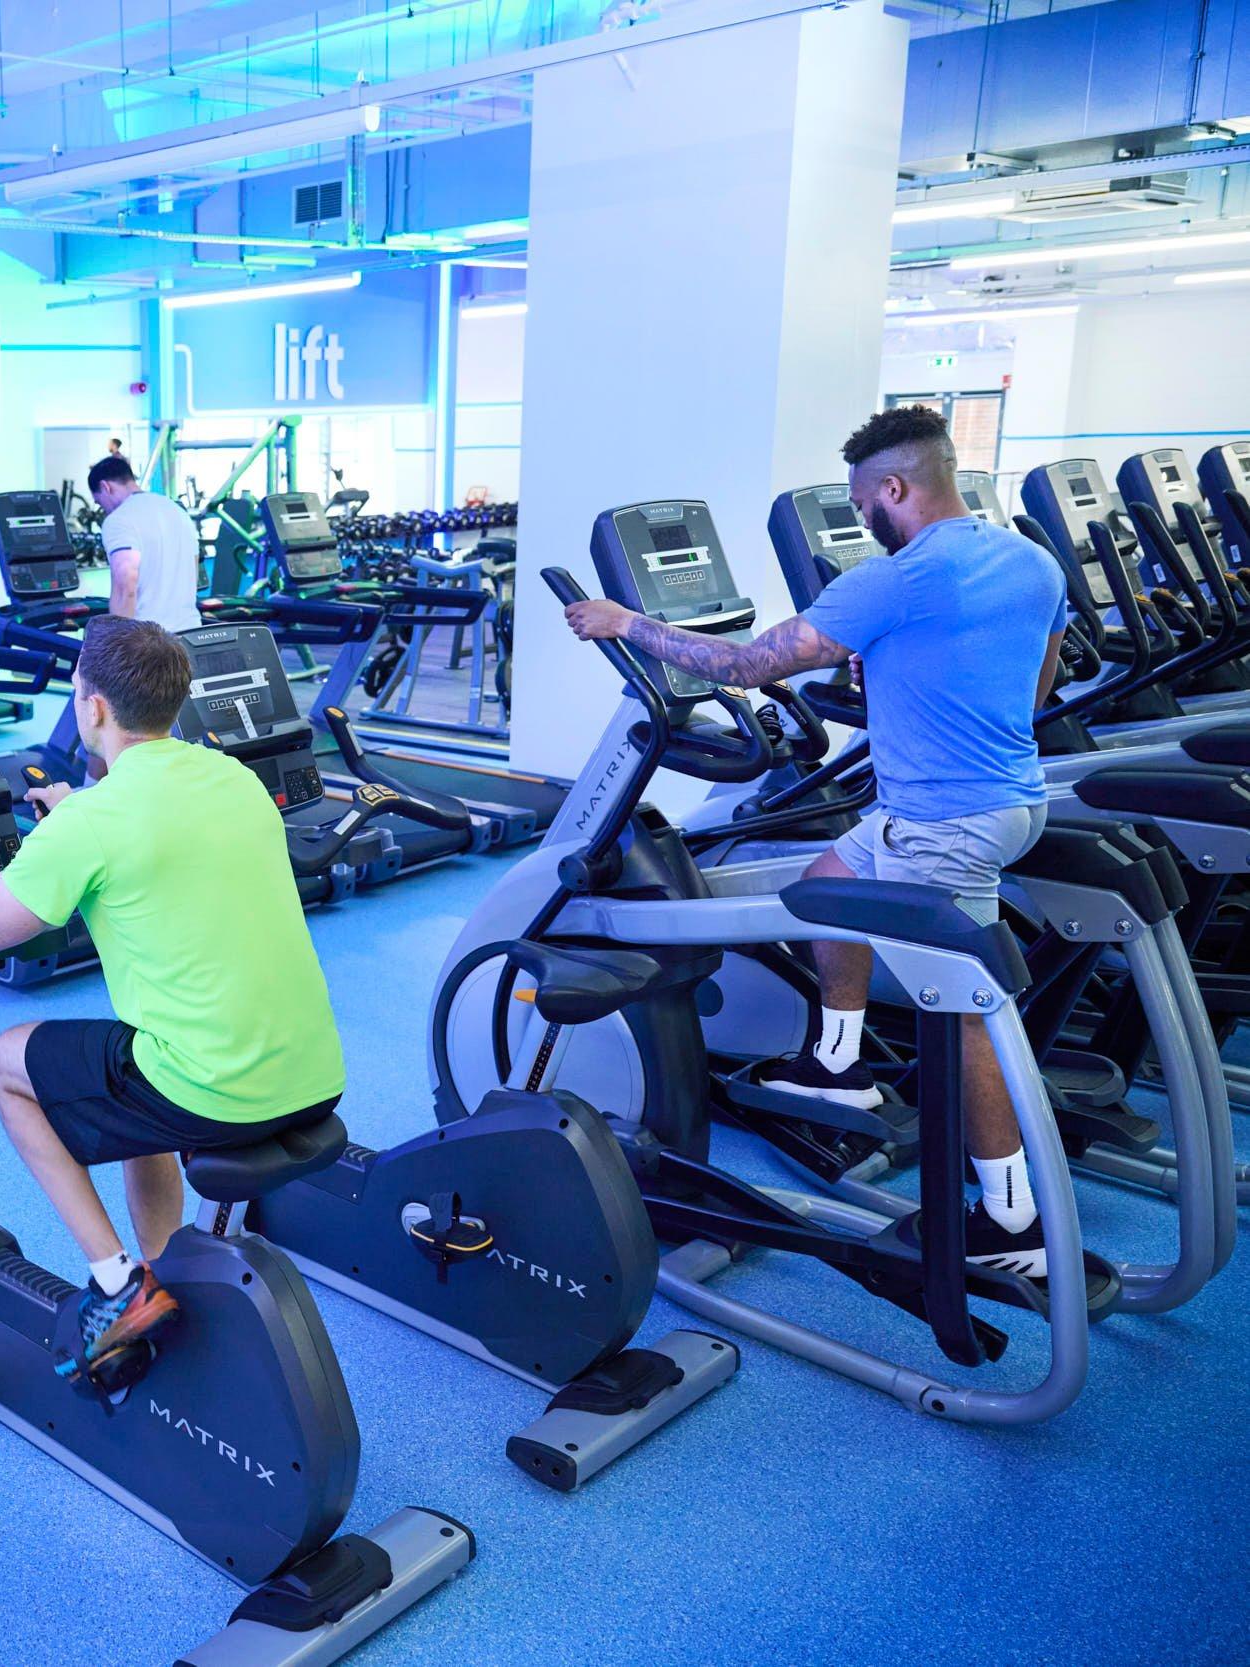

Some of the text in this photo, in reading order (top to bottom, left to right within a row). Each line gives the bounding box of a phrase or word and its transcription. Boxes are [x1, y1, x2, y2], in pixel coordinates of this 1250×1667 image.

[274, 322, 344, 400] lift
[197, 631, 228, 641] MATRIX
[575, 741, 631, 831] MATRIX
[486, 1248, 587, 1299] ATRIX
[150, 1398, 276, 1488] MATRIX
